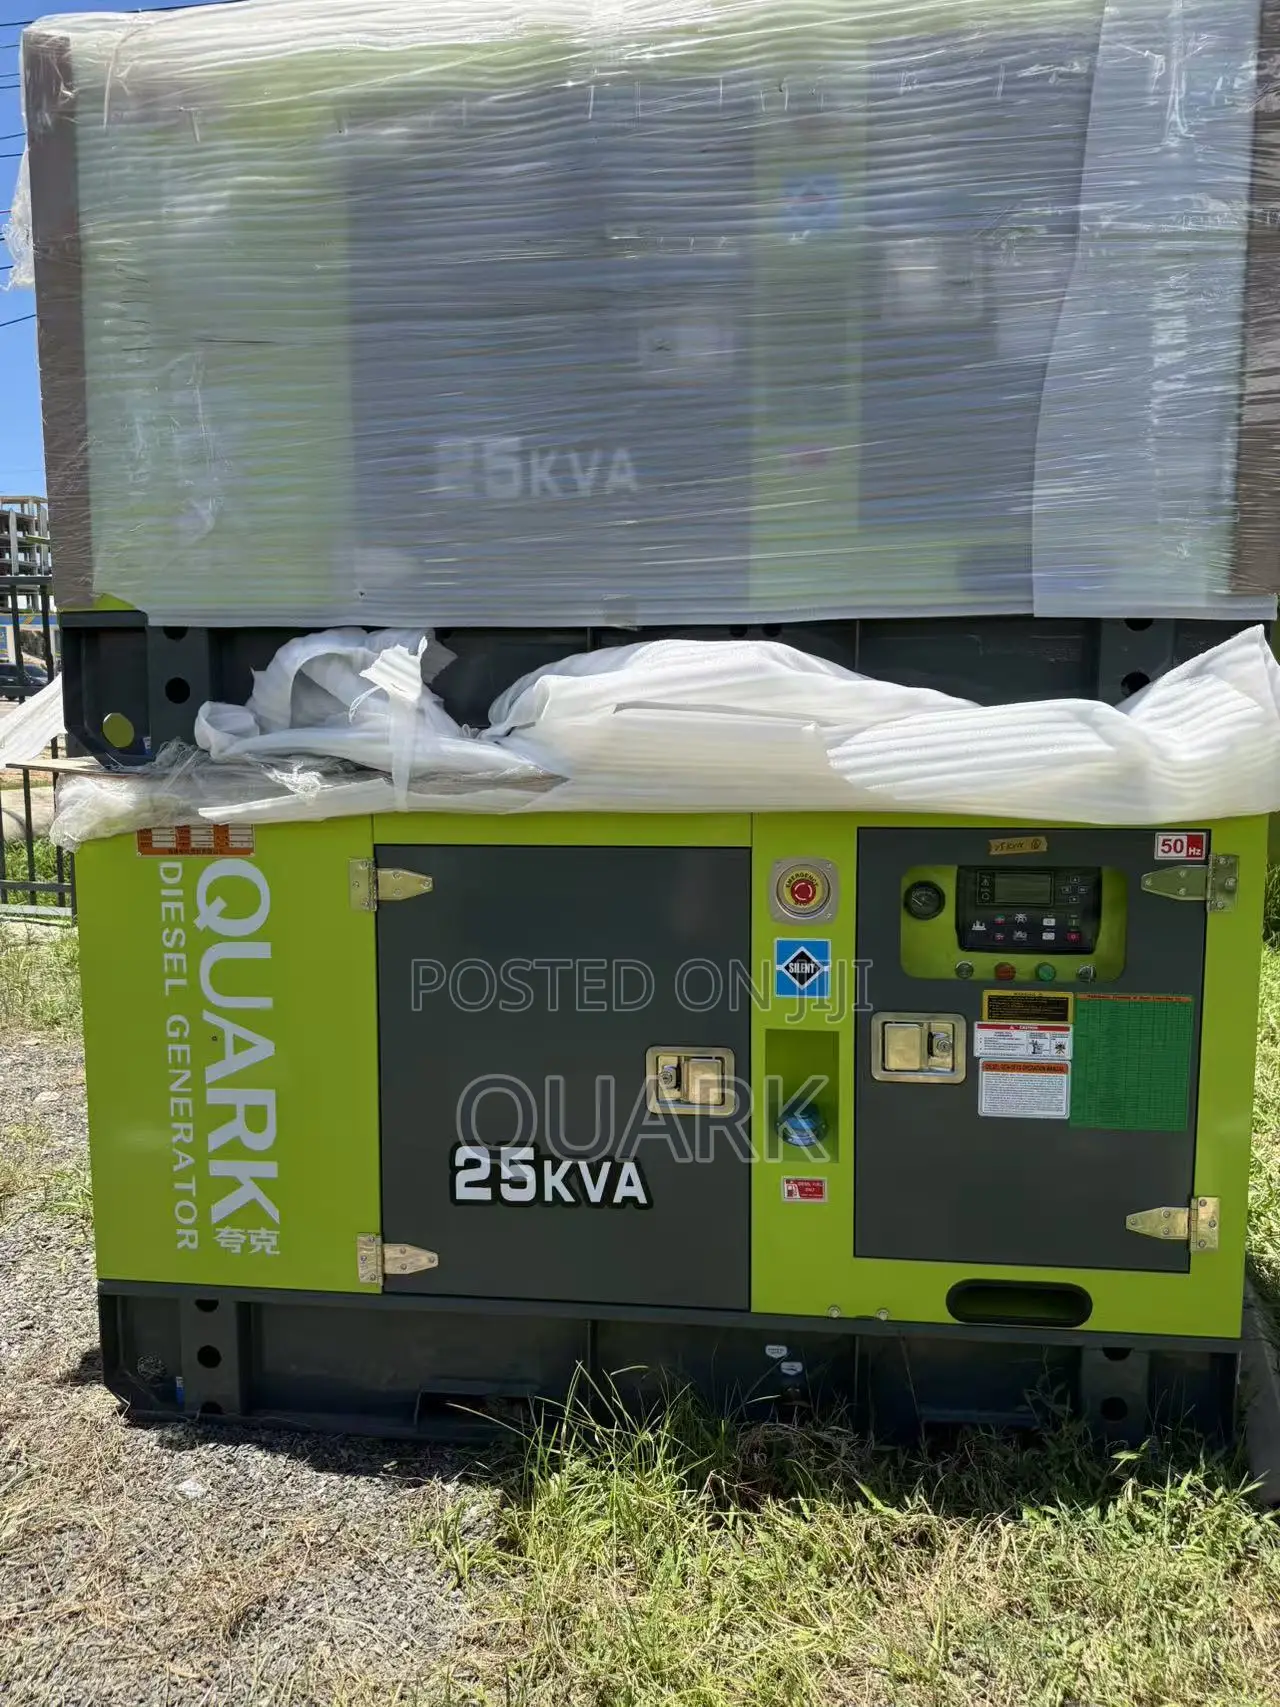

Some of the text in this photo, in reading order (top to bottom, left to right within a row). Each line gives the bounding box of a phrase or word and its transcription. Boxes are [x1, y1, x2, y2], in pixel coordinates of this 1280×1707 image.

[1161, 838, 1202, 856] 50 Hz
[785, 872, 819, 888] EMERGENCY
[788, 962, 816, 974] SILENT
[193, 858, 280, 1225] QUARK
[159, 862, 199, 1250] DIESEL GENERATOR
[454, 1145, 648, 1204] 25KVA
[214, 1226, 280, 1254] 夸克
